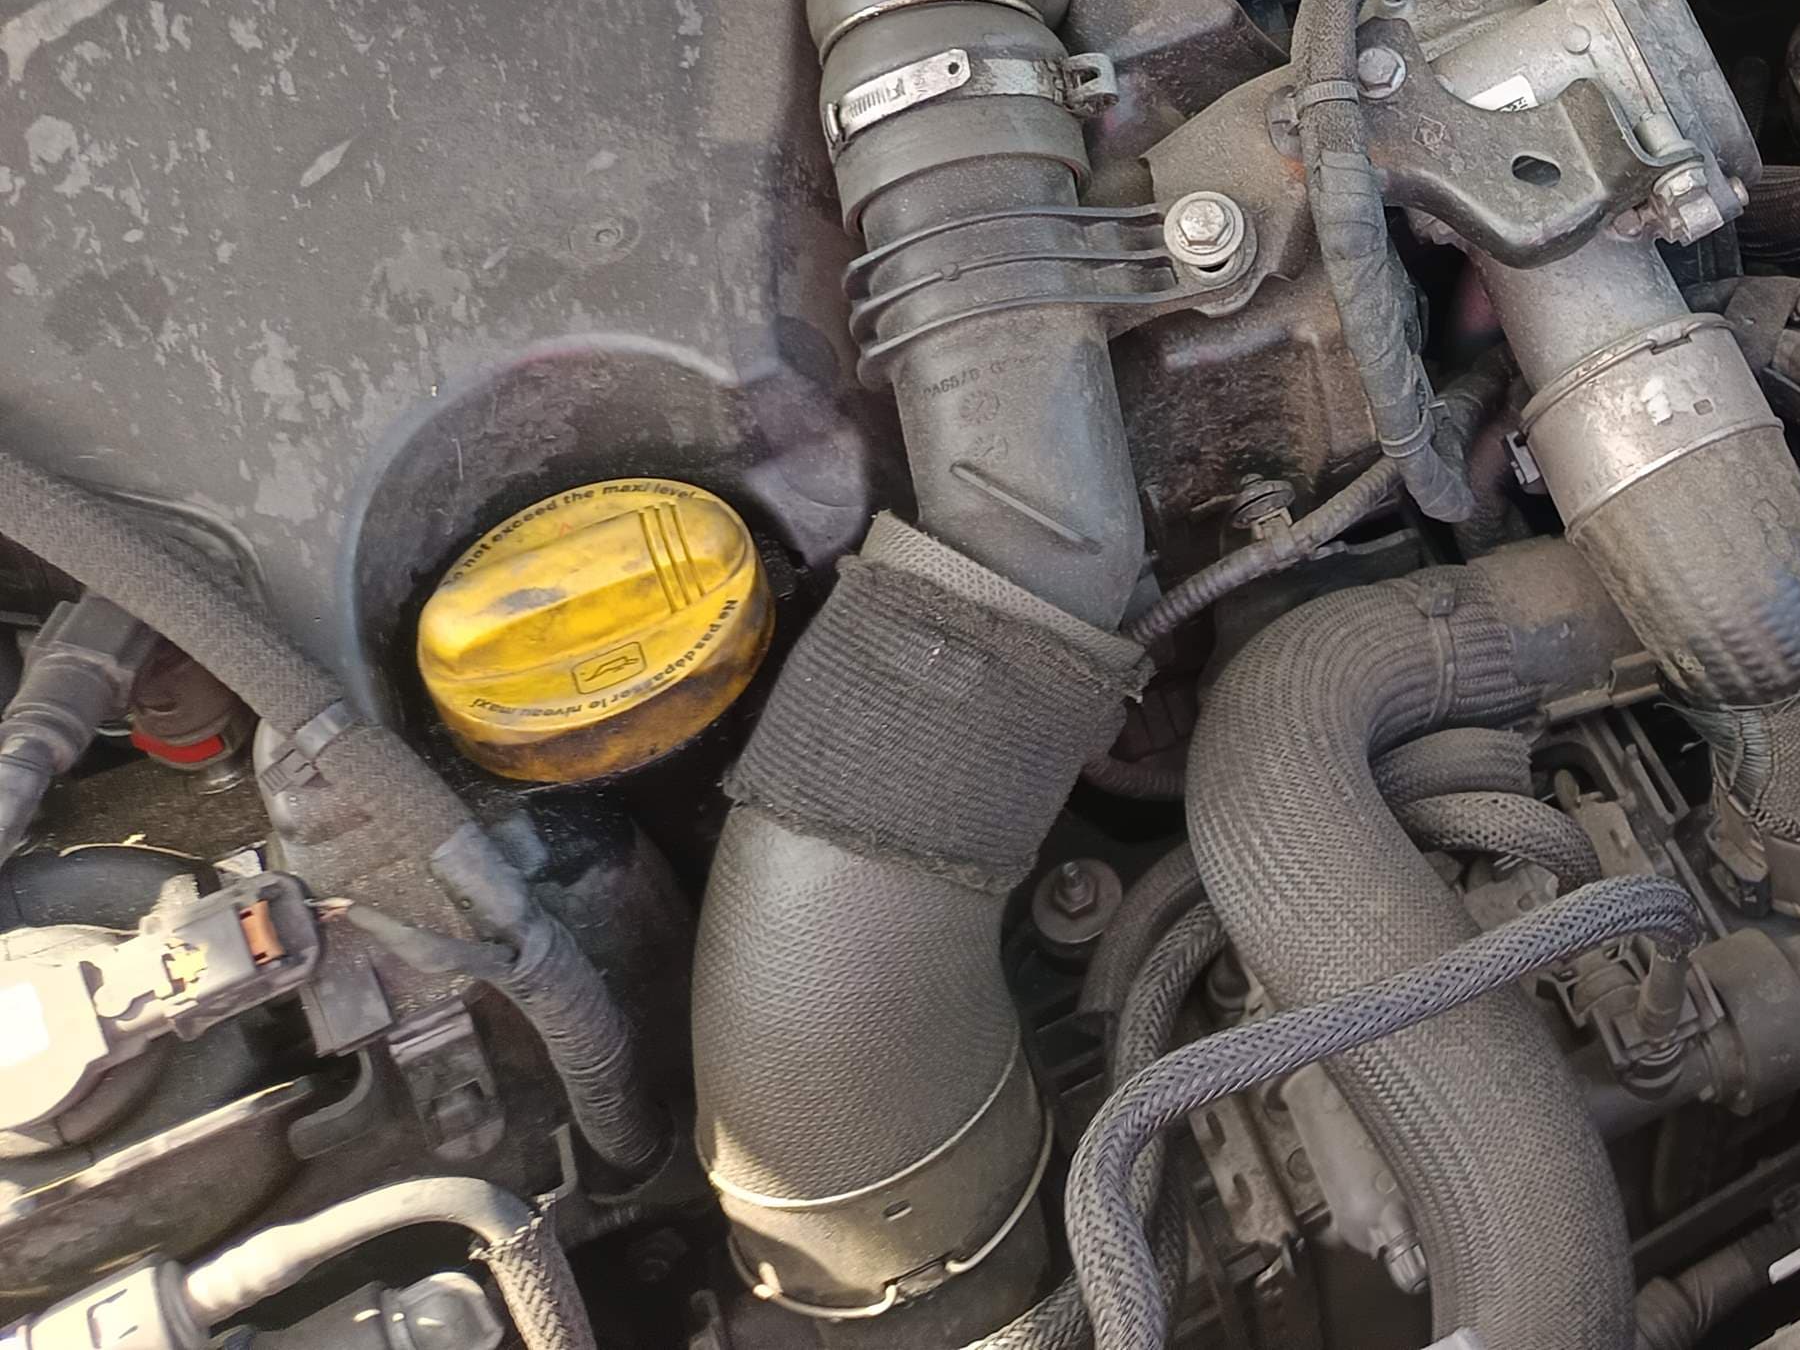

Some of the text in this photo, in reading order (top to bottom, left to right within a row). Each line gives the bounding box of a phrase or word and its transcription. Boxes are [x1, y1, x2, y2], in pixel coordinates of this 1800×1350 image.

[462, 542, 493, 569] not
[491, 500, 558, 544] exceed
[563, 489, 596, 505] the
[602, 482, 651, 495] maxi
[654, 483, 697, 499] level
[719, 598, 739, 620] Ne
[693, 623, 722, 650] pas
[469, 697, 515, 715] maxi
[520, 704, 582, 718] niveau
[589, 698, 607, 708] le
